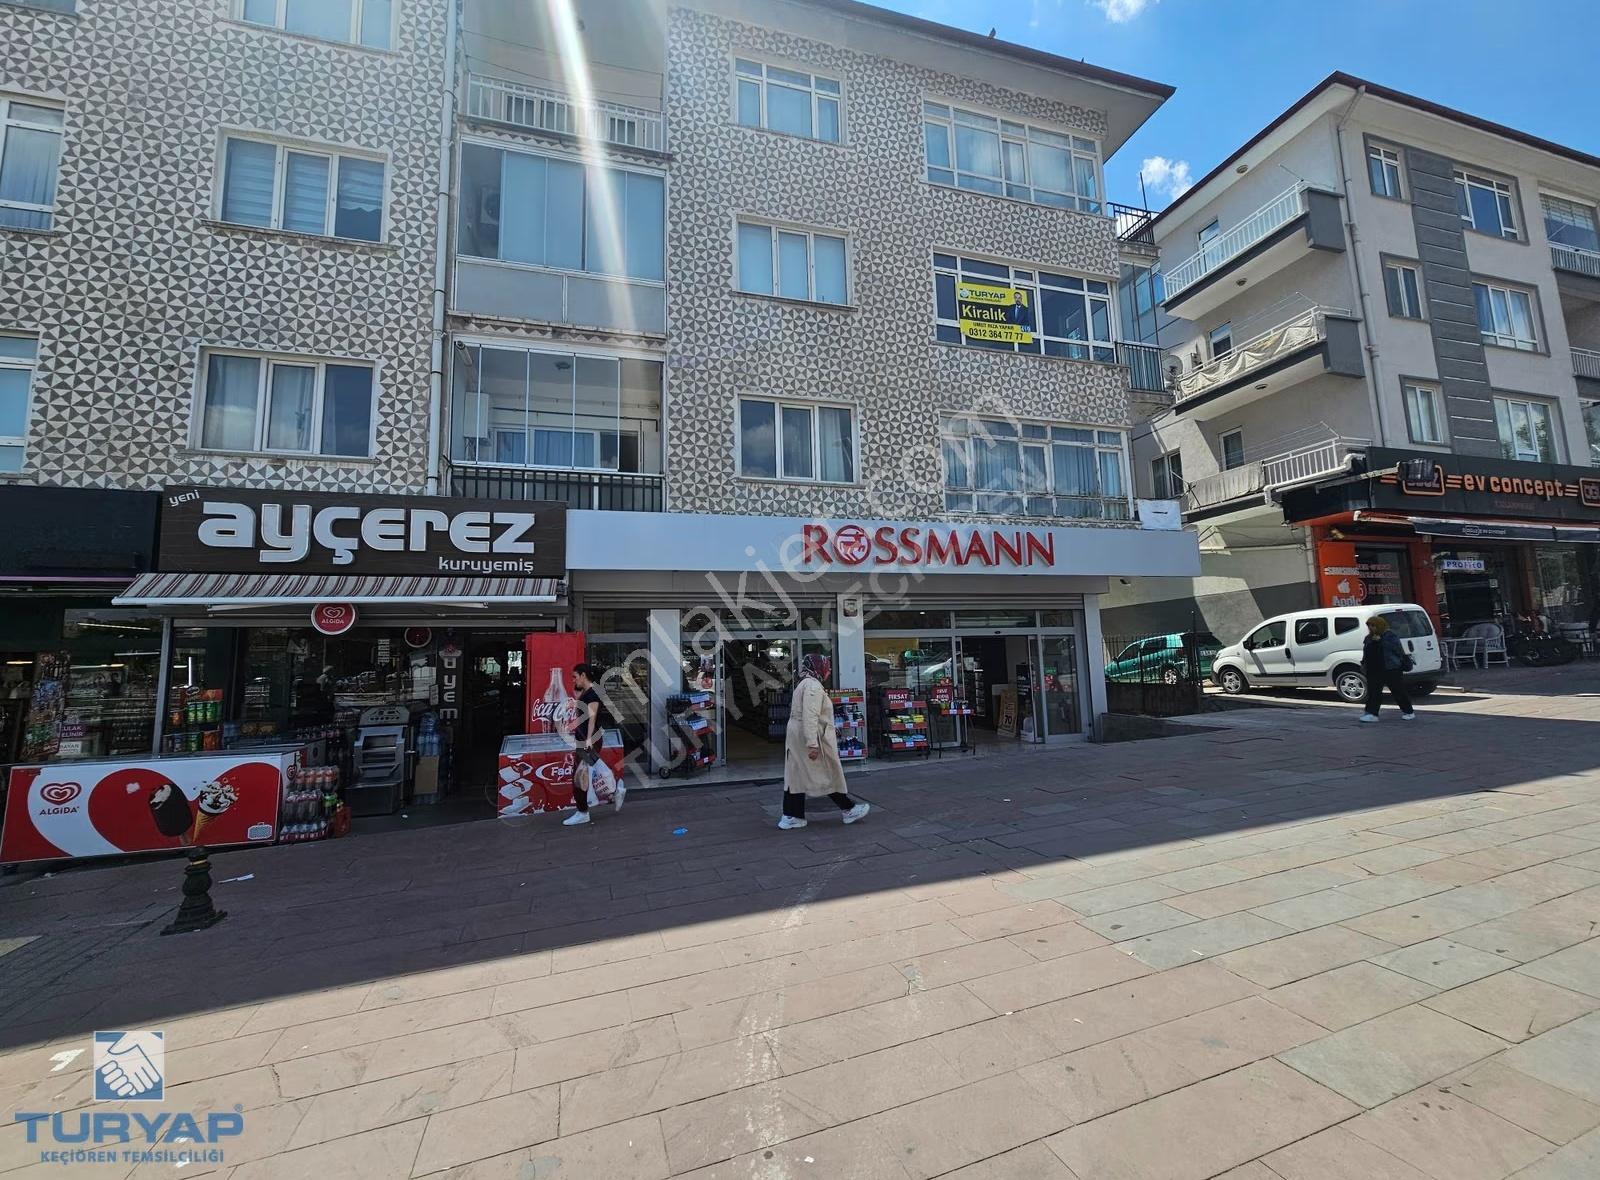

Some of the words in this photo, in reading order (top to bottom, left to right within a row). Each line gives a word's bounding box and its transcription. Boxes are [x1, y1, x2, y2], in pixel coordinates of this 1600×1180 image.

[969, 289, 1006, 299] TURYAP
[962, 304, 1006, 321] Kiralık
[969, 327, 986, 337] 0312
[988, 329, 1002, 338] 364
[1004, 331, 1013, 340] 77
[1015, 332, 1023, 341] 77
[1464, 474, 1485, 491] ev
[1490, 476, 1564, 498] concept
[168, 489, 200, 507] yeni
[197, 501, 535, 565] ayçerez
[803, 524, 1055, 567] ROSSMANN
[438, 556, 534, 574] kuruyemiş
